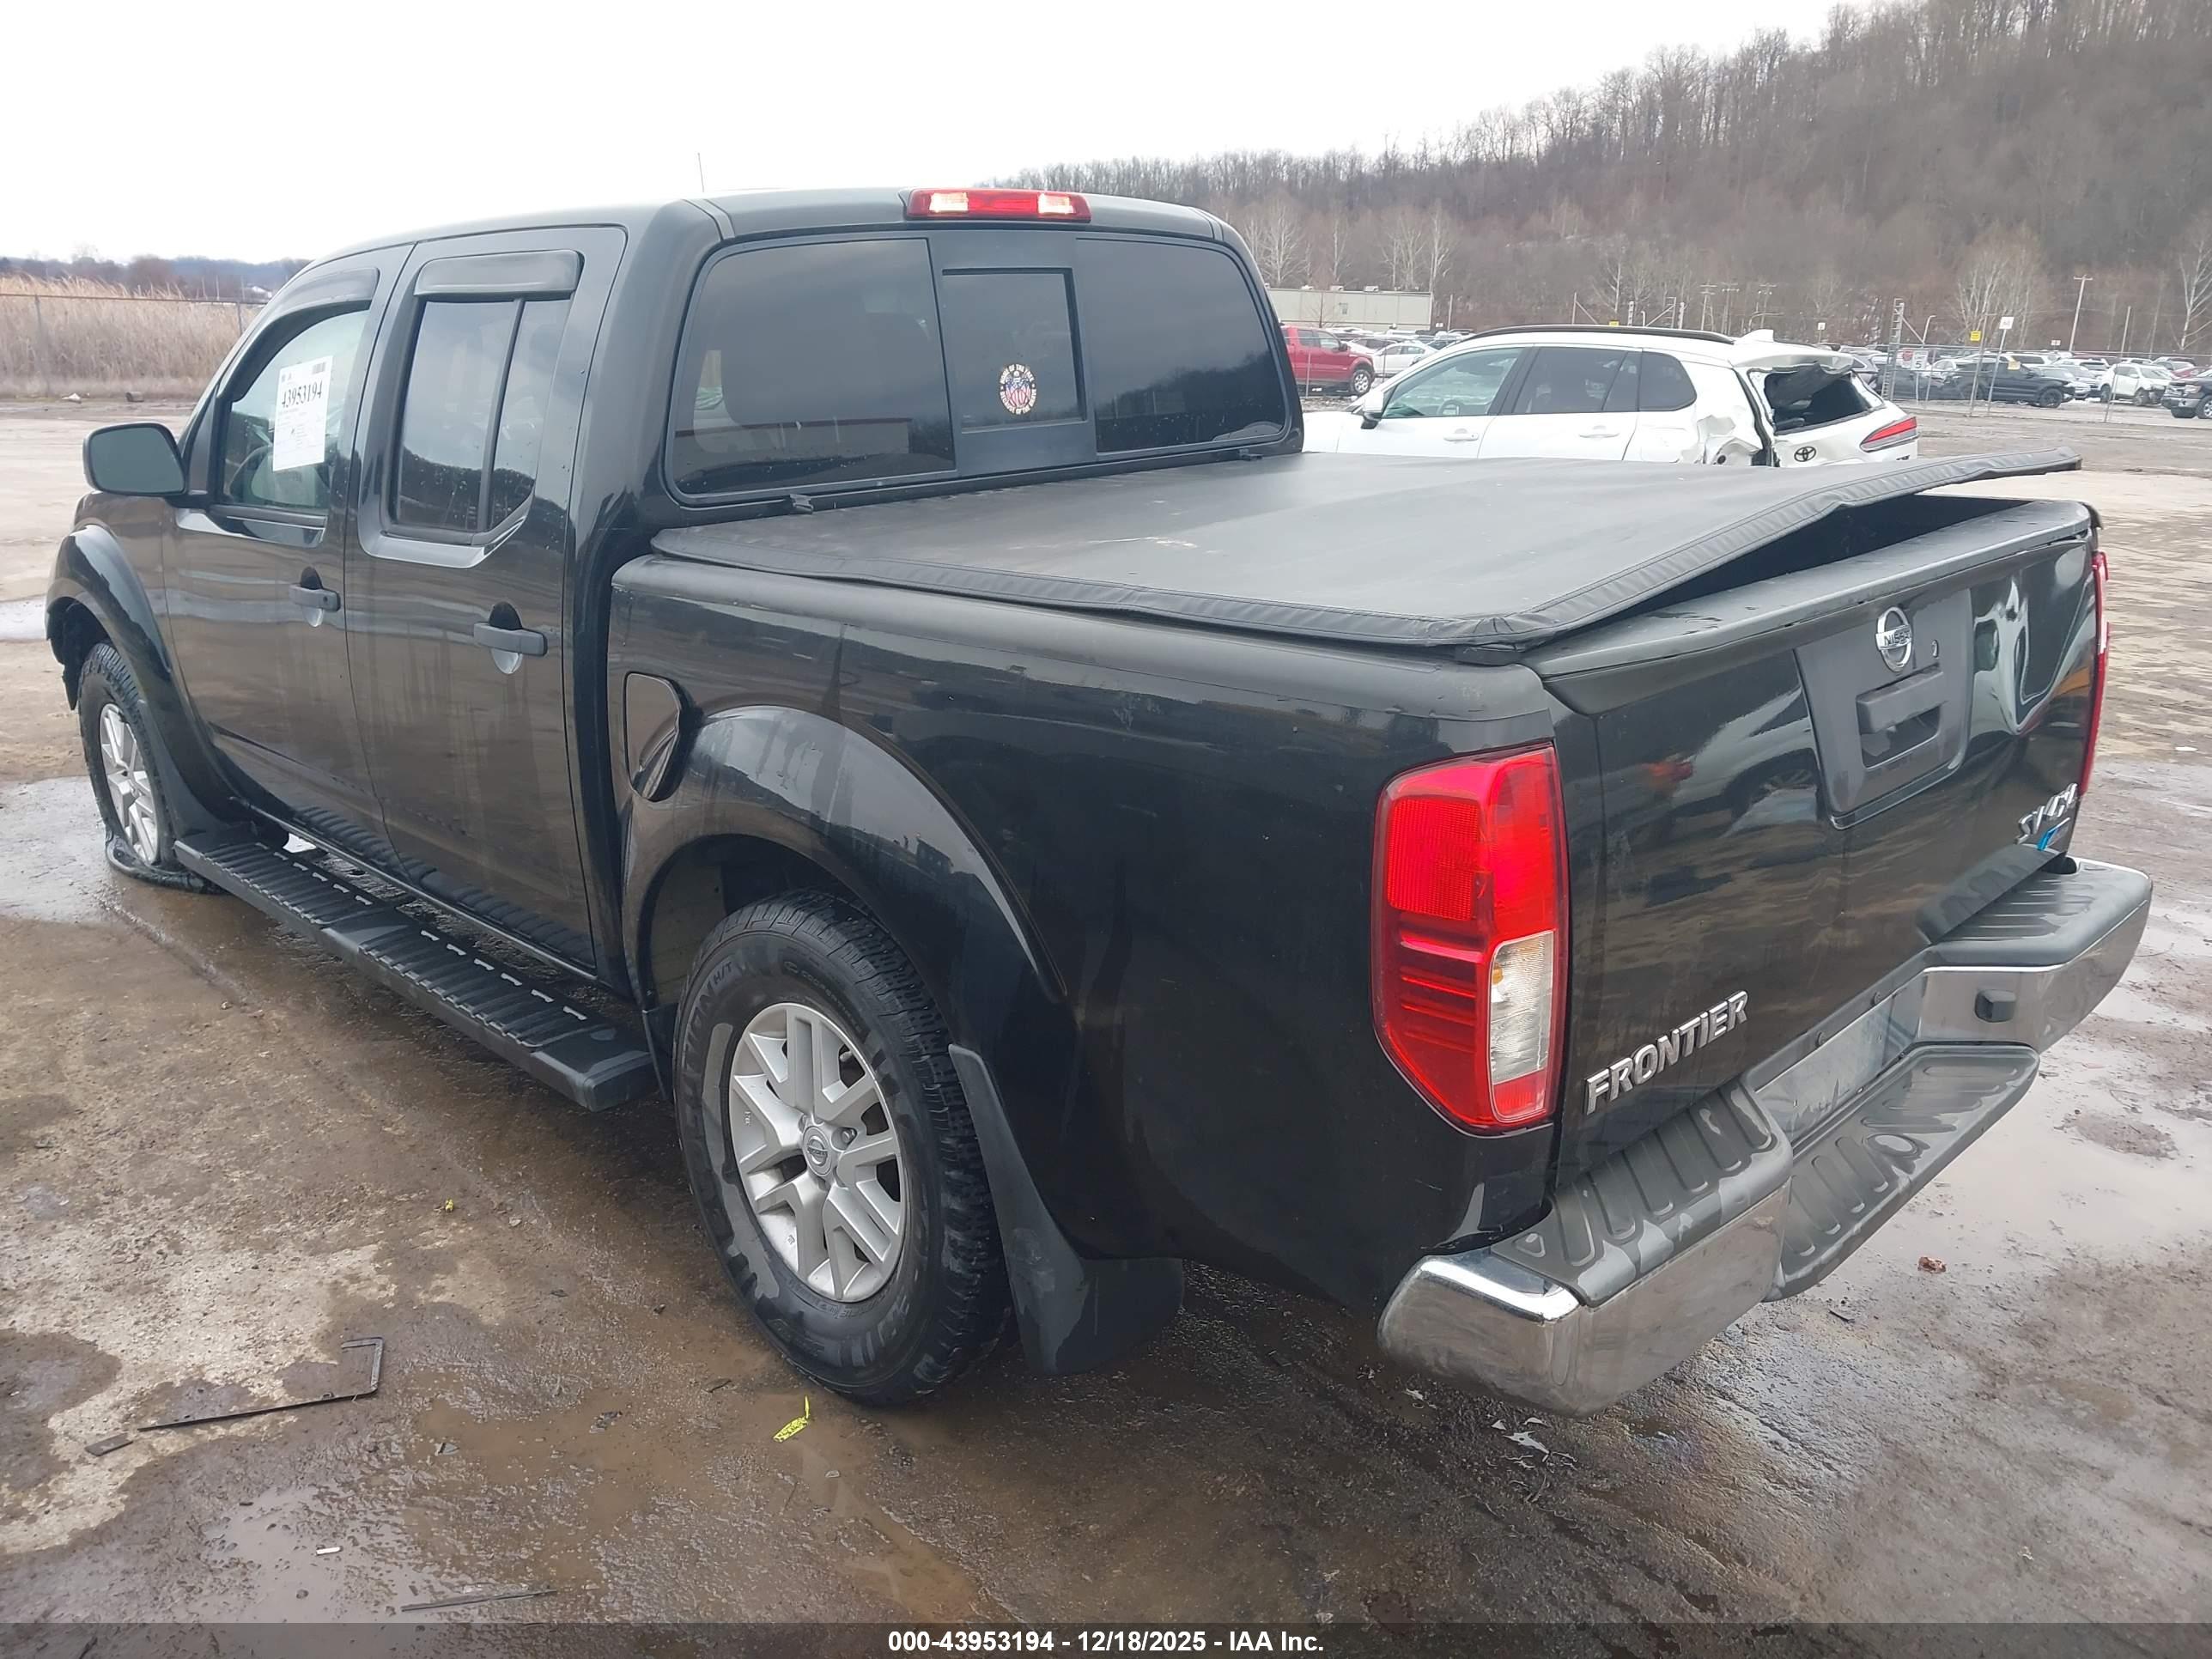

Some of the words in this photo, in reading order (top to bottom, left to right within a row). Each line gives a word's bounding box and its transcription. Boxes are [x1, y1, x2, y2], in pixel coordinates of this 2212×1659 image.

[1915, 361, 1923, 369] 5
[282, 380, 322, 407] 43953194
[1583, 990, 1748, 1115] FRONTIER
